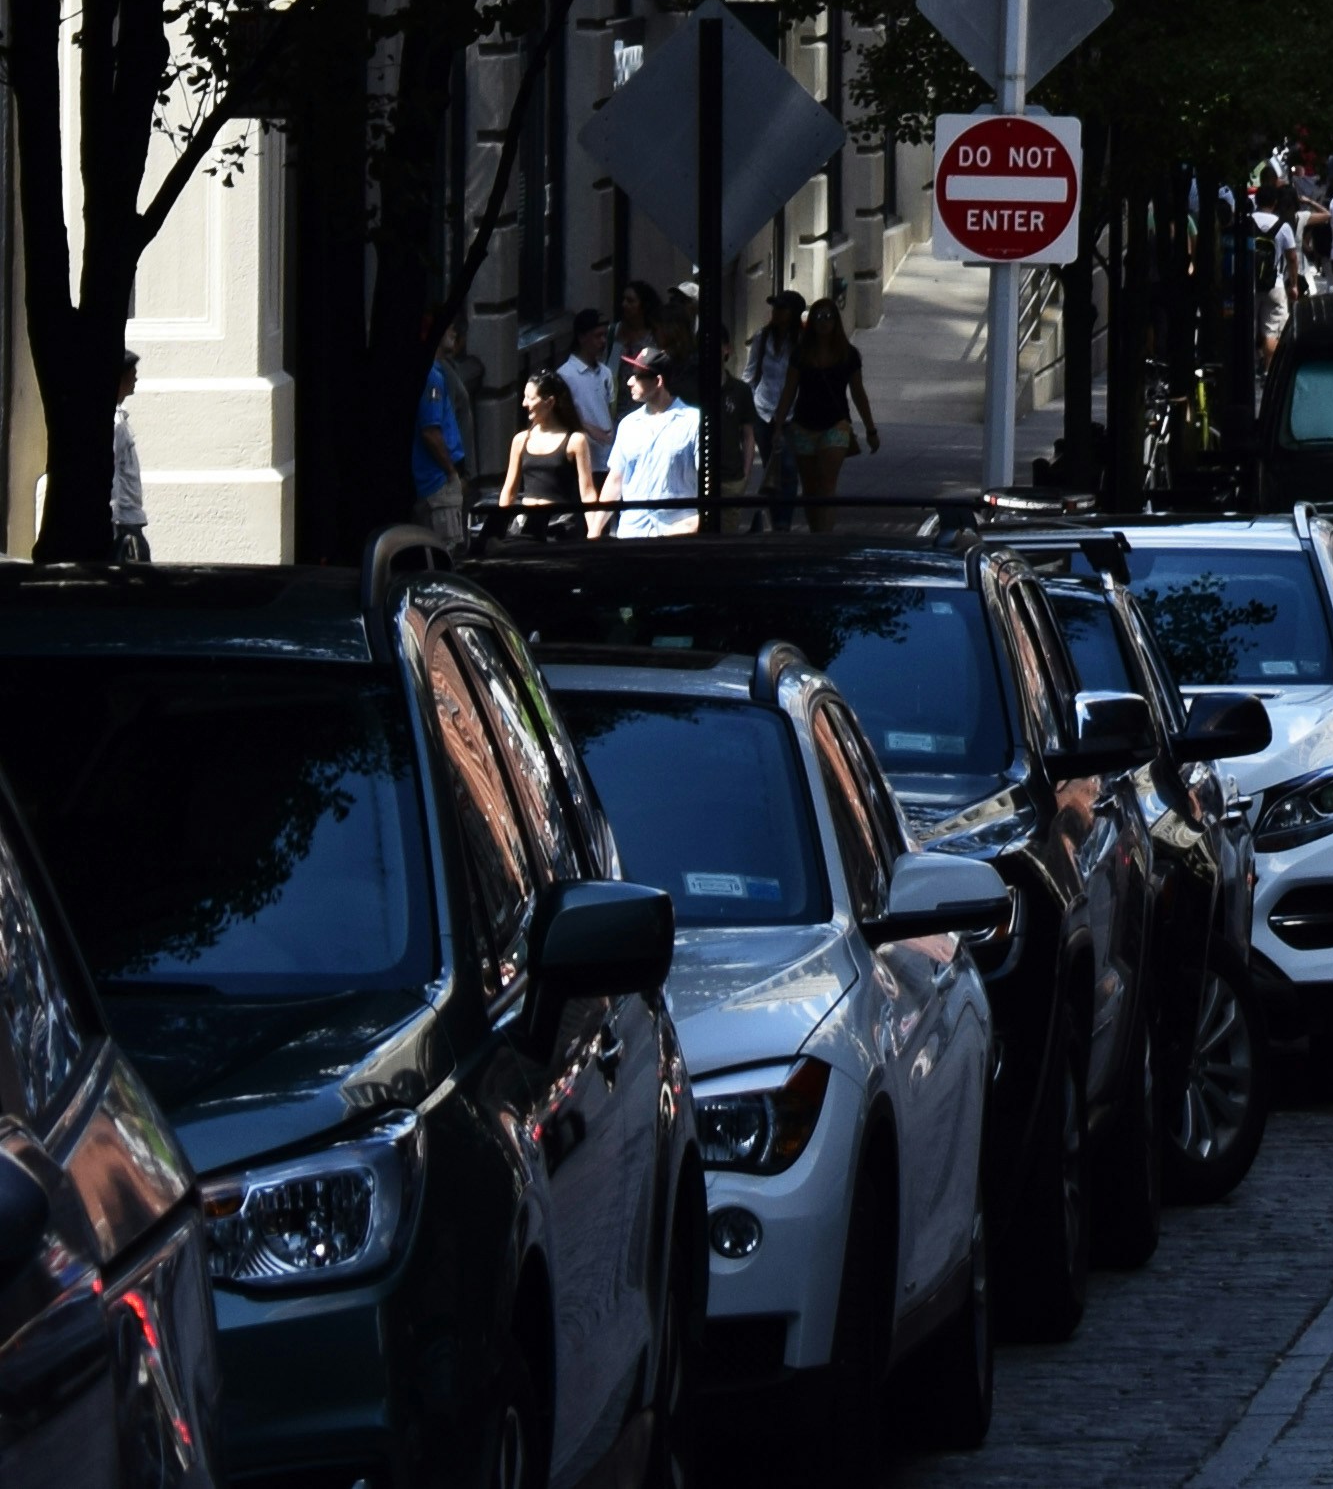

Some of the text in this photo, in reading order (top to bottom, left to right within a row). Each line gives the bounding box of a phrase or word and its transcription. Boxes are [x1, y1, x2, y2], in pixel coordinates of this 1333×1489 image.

[958, 145, 1056, 169] DO NOT
[966, 209, 1044, 232] ENTER
